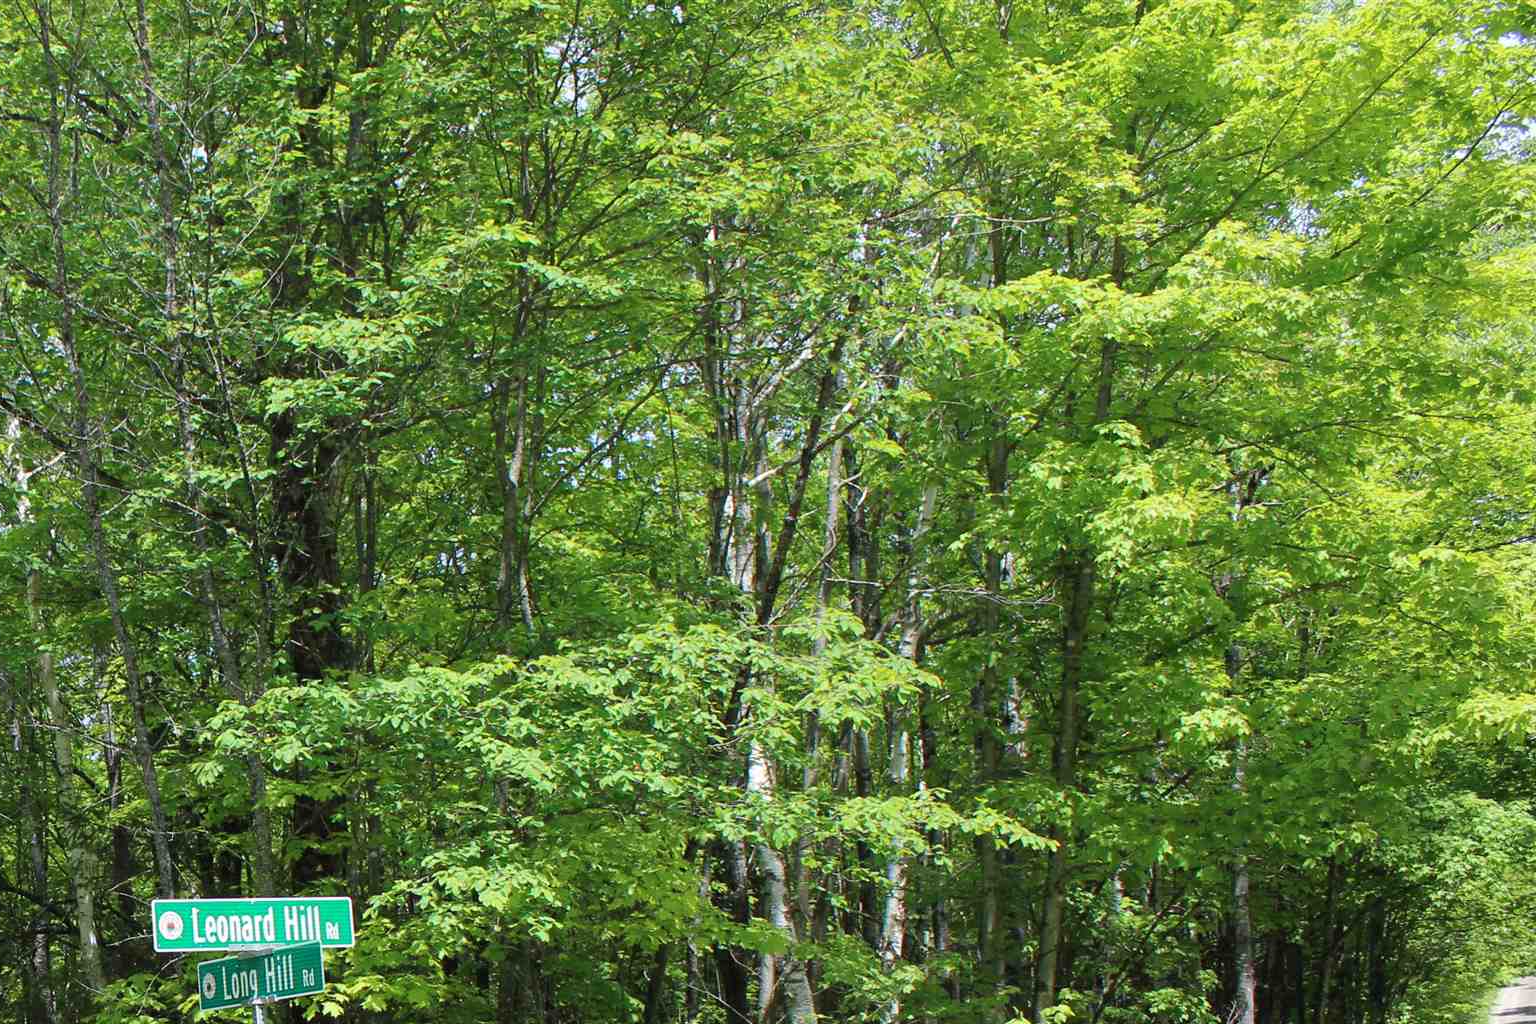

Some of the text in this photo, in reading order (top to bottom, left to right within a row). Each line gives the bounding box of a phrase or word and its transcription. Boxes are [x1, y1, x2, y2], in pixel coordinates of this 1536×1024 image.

[192, 905, 340, 943] Leonard Hill Rd
[222, 954, 315, 1001] Long Hill Rd
